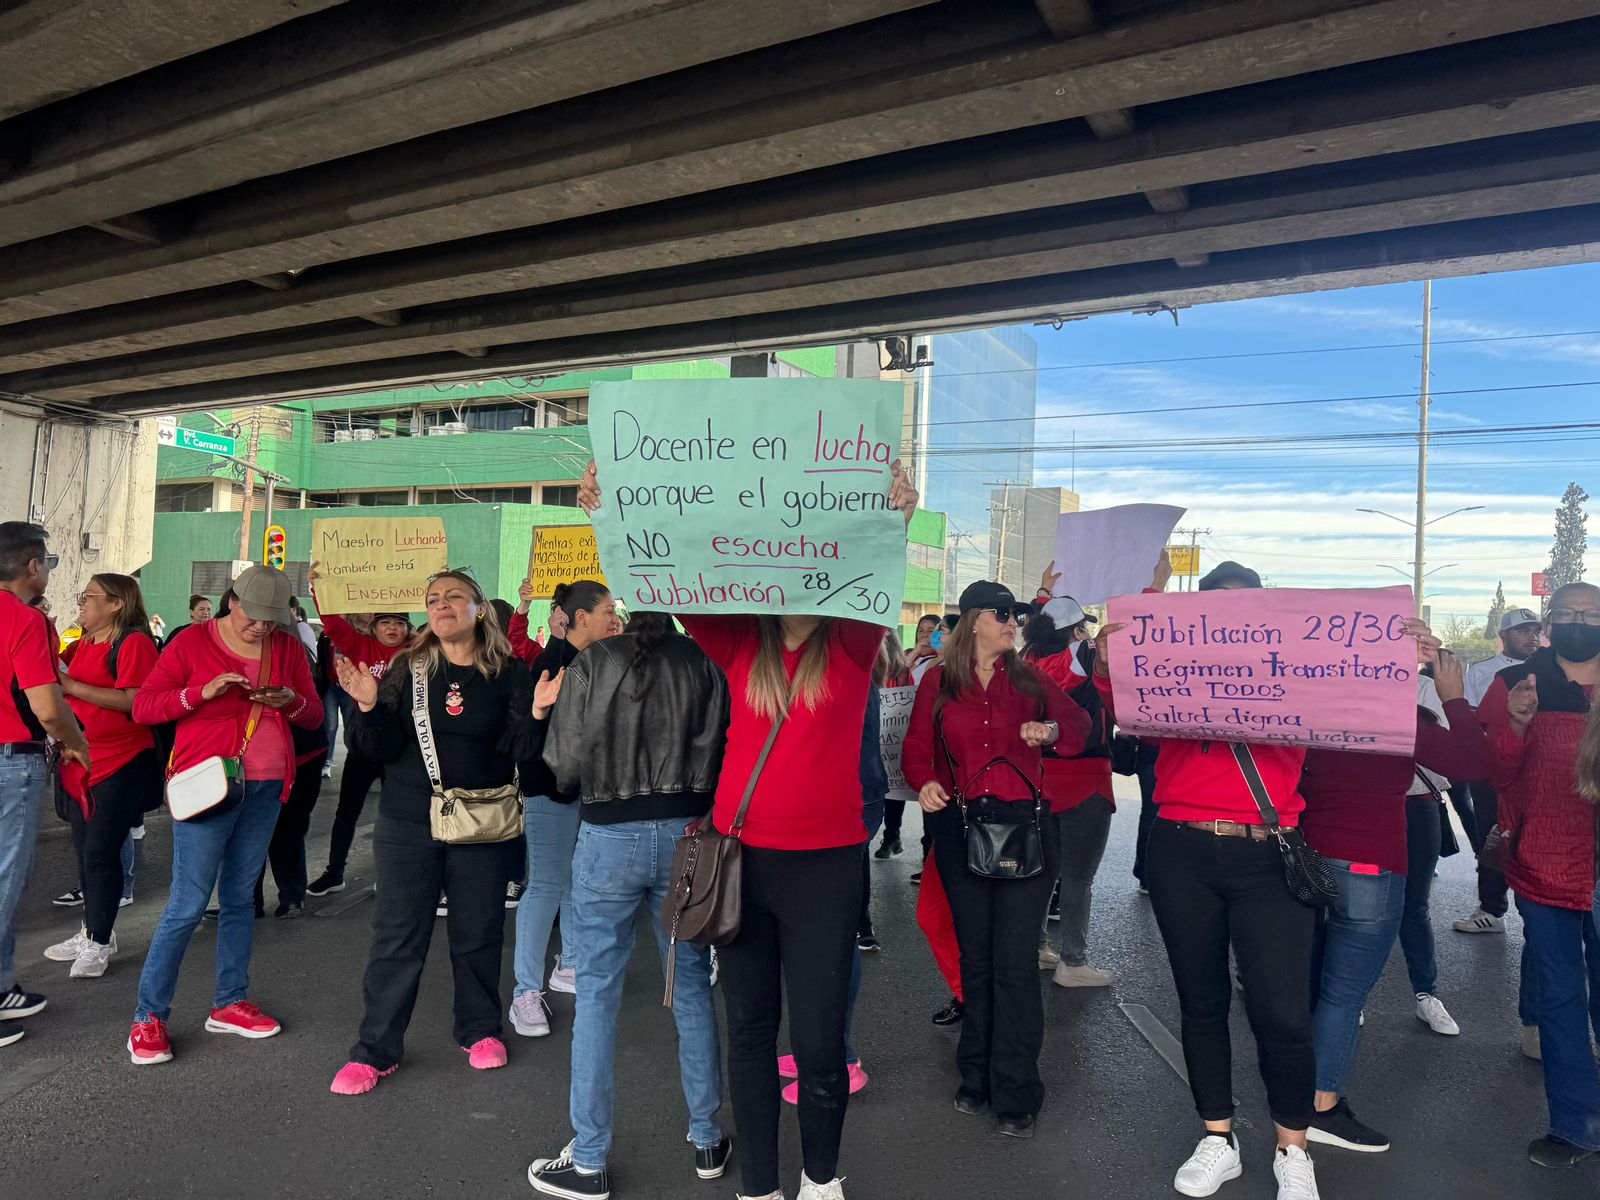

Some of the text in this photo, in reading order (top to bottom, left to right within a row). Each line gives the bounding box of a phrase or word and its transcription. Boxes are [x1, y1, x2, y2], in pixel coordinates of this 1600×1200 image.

[184, 437, 228, 452] V. Carranza
[613, 410, 891, 464] Docente en lucha
[616, 484, 715, 522] porque
[739, 476, 766, 508] el
[323, 527, 447, 552] Maestro Luchando
[534, 531, 573, 551] Mientras
[626, 529, 847, 560] NO escucha.
[327, 559, 414, 575] también está
[533, 550, 573, 564] maestros
[577, 550, 588, 561] de
[532, 567, 545, 579] no
[537, 581, 551, 593] de
[630, 572, 890, 615] Jubilación 28/30
[1130, 614, 1282, 646] Jubilación
[1134, 651, 1410, 685] Régimen transitorio
[880, 690, 917, 705] PETIC
[1136, 682, 1286, 703] para TODOS
[1137, 705, 1302, 731] Salud digna
[418, 719, 431, 750] LOLA
[1307, 729, 1377, 743] lucha
